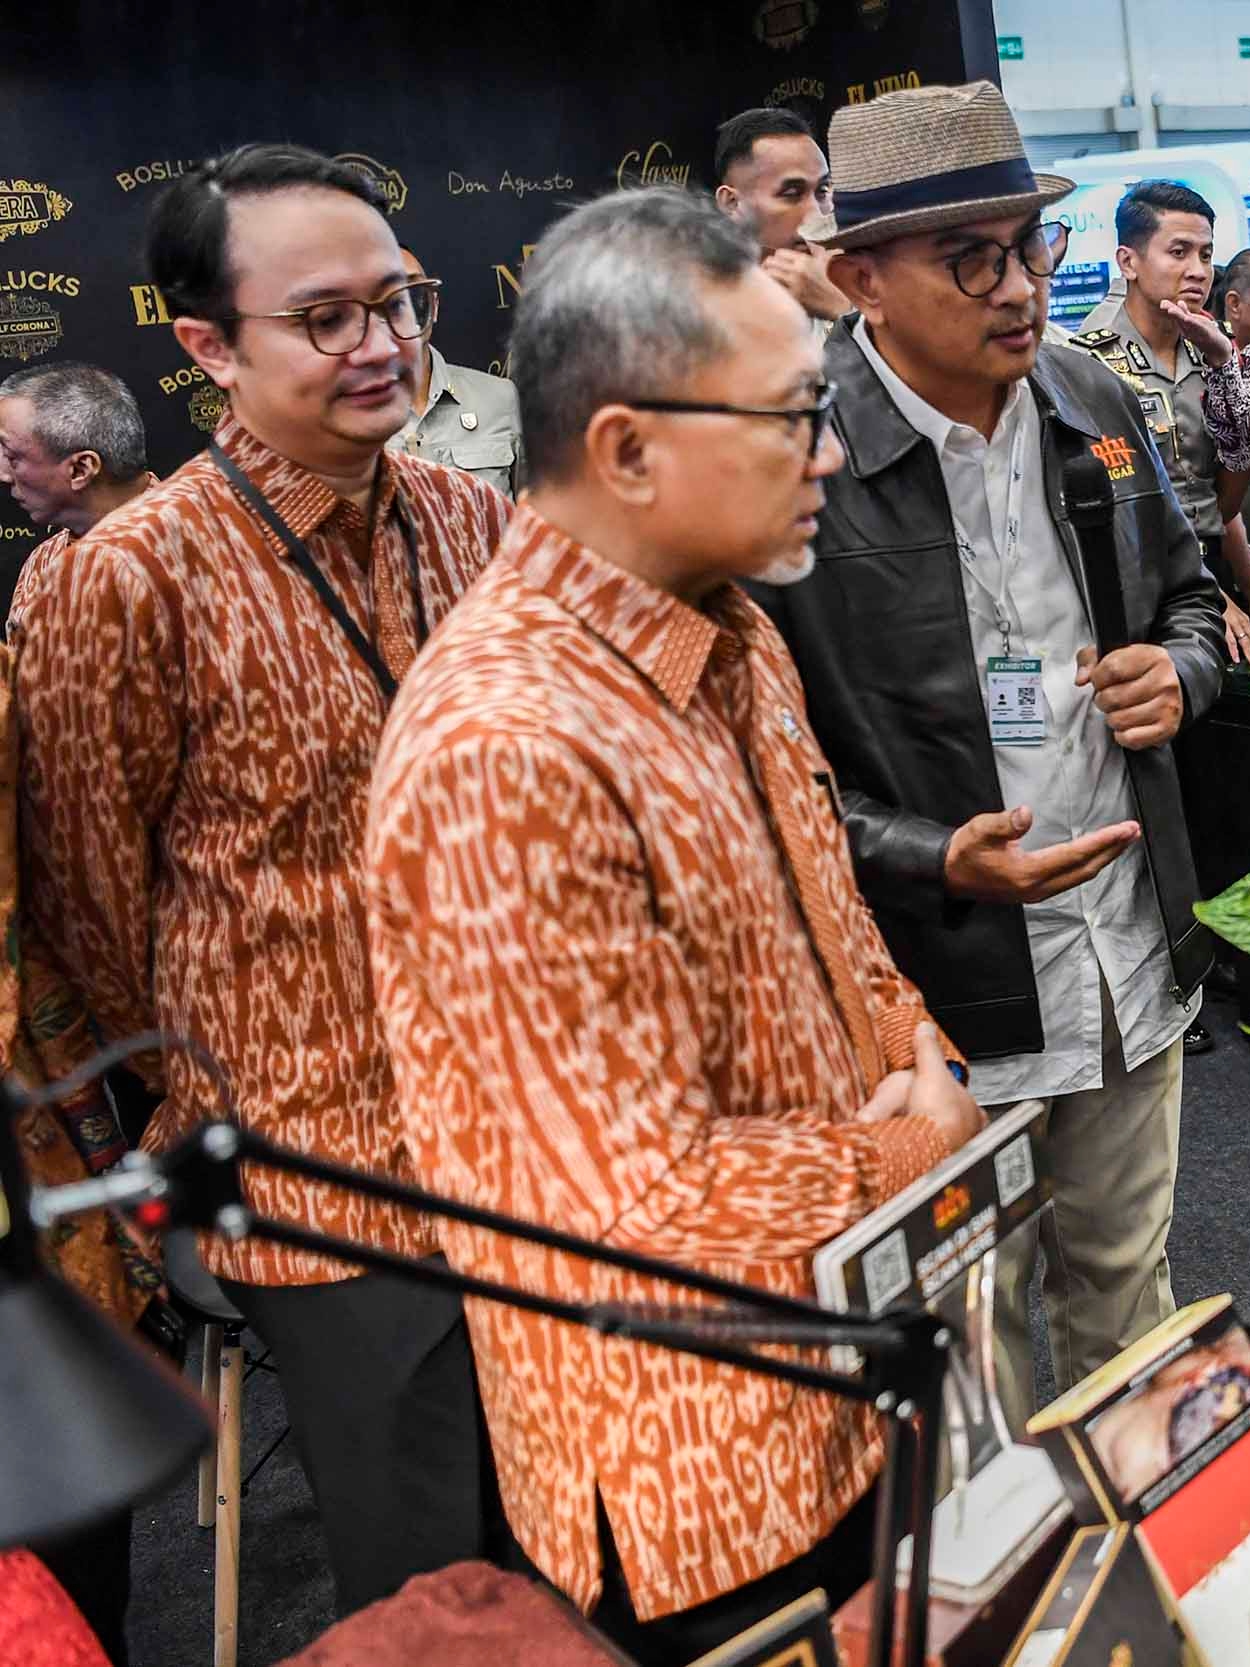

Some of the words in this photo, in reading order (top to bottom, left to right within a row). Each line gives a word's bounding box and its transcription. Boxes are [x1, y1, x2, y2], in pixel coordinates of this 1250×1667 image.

[448, 171, 489, 194] Don
[499, 170, 574, 199] Agusto
[10, 321, 50, 332] CORONA
